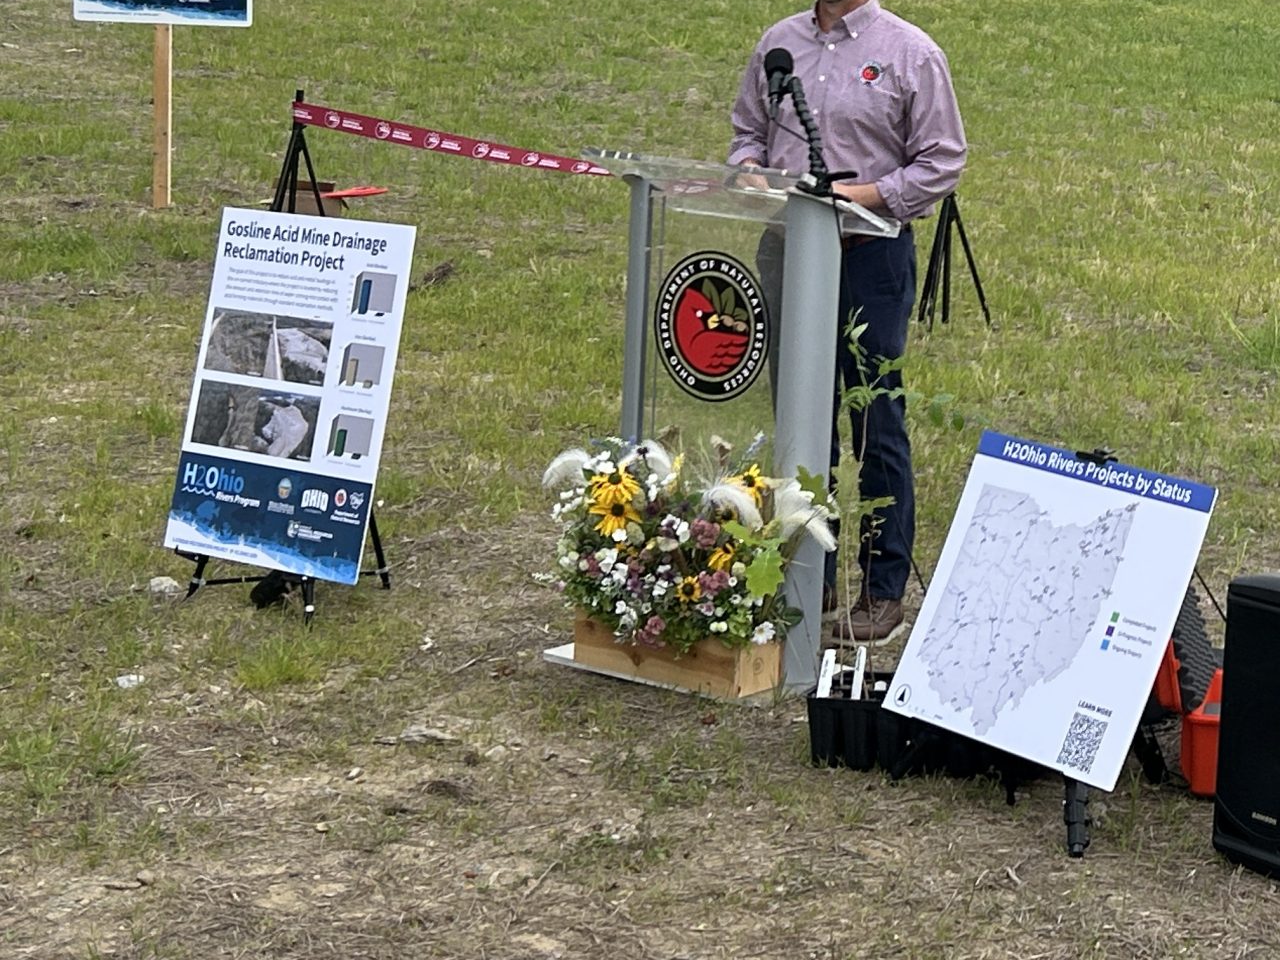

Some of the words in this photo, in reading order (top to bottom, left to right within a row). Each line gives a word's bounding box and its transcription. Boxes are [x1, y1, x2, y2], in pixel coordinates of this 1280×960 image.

[227, 220, 271, 240] Gosline
[273, 224, 298, 243] Acid
[301, 228, 330, 247] Mine
[332, 231, 387, 256] Drainage
[224, 242, 299, 265] Reclamation
[301, 251, 345, 272] Project
[699, 260, 715, 269] OF
[720, 263, 762, 315] NATURAL
[661, 264, 696, 349] DEPARTMENT
[670, 356, 696, 386] OHIO
[724, 323, 764, 391] RESOURCES
[183, 462, 244, 493] H2Ohio
[1003, 440, 1047, 465] H2Ohio
[1048, 451, 1085, 476] Rivers
[1085, 464, 1135, 489] Projects
[1135, 473, 1152, 495] by
[1152, 478, 1192, 503] Status
[301, 489, 329, 512] OHIO
